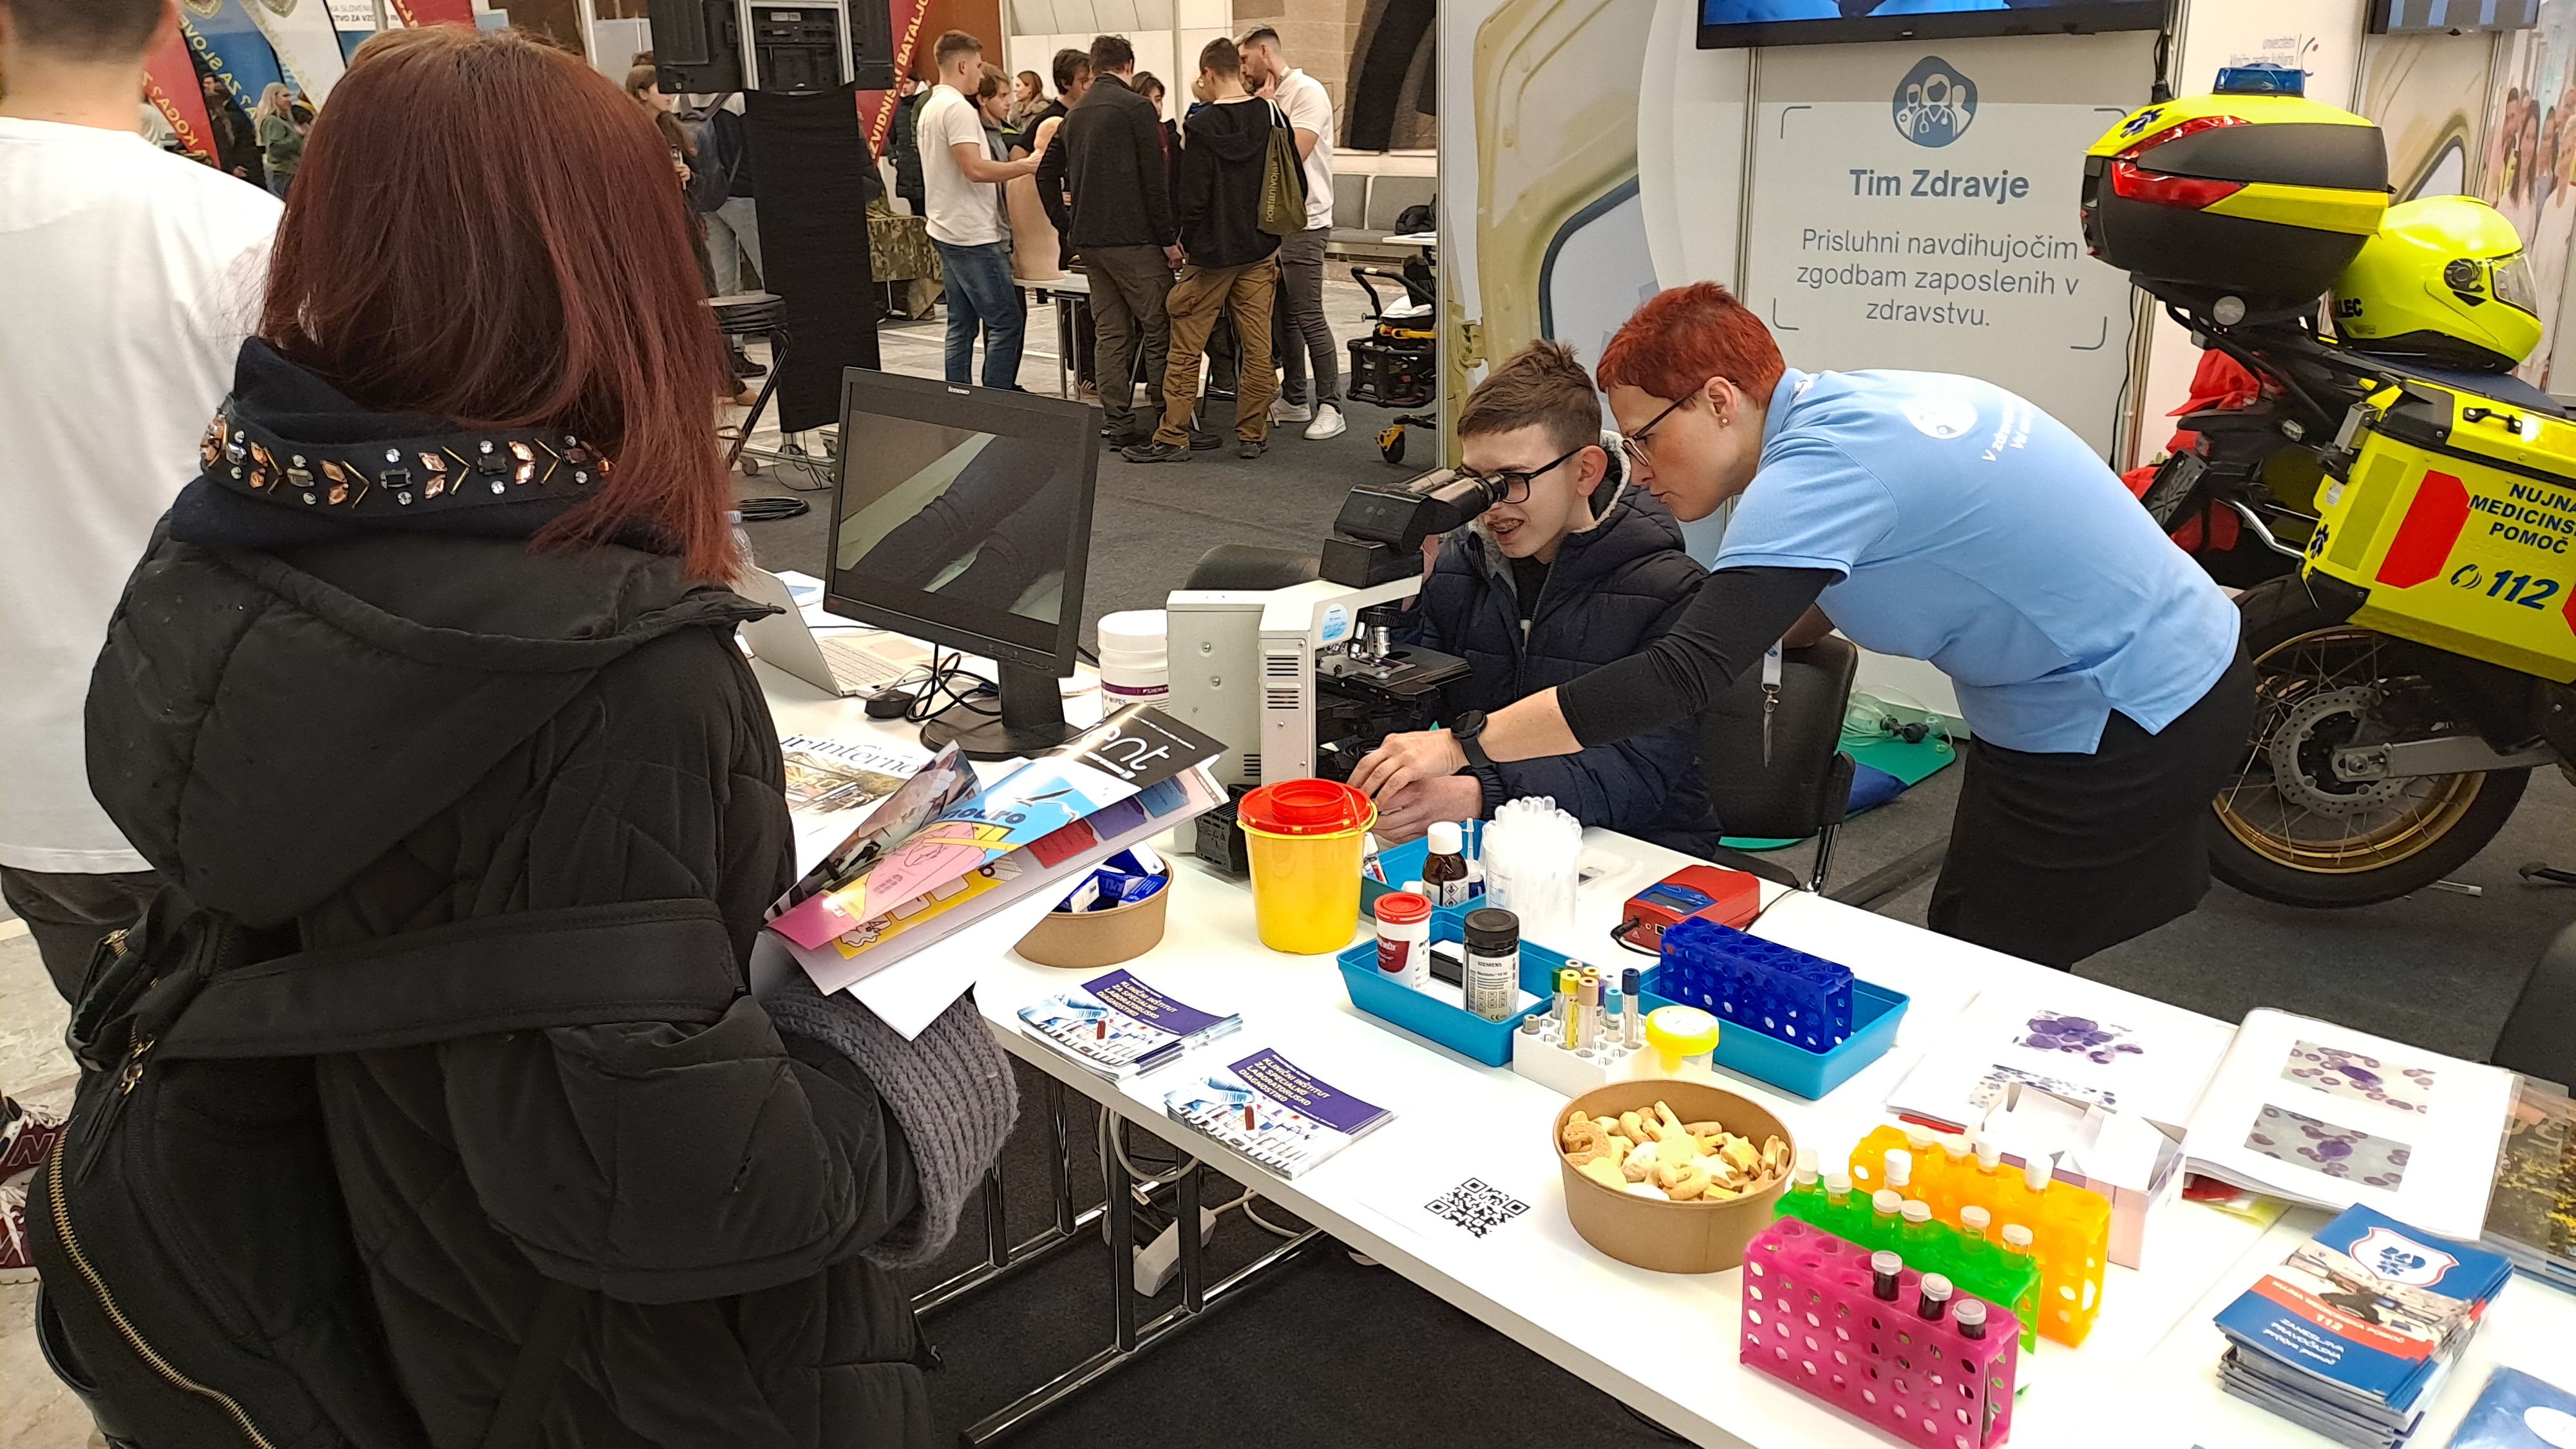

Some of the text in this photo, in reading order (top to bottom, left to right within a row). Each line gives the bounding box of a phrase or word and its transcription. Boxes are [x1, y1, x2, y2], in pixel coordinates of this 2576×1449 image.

[896, 0, 929, 66] BATALJO
[1266, 149, 1280, 223] postanivojak
[1850, 169, 2030, 205] Tim Zdravje
[1803, 229, 2078, 263] Prisluhni navdihujočim
[1796, 263, 2079, 296] zgodbam zaposlenih v
[1866, 298, 1991, 327] zdravstvu.
[2468, 495, 2576, 536] MEDICINS
[2488, 522, 2570, 554] POMOČ
[2486, 569, 2560, 611] 112
[1109, 697, 1128, 706] WIPES
[1238, 1069, 1288, 1103] DIAGNOSTIKO
[1254, 1061, 1267, 1071] ZA
[1265, 1068, 1308, 1096] SPECIALNO
[1262, 1057, 1294, 1082] KLINIČNI
[1292, 1078, 1331, 1099] INŠTITUT
[2316, 1313, 2345, 1332] 112
